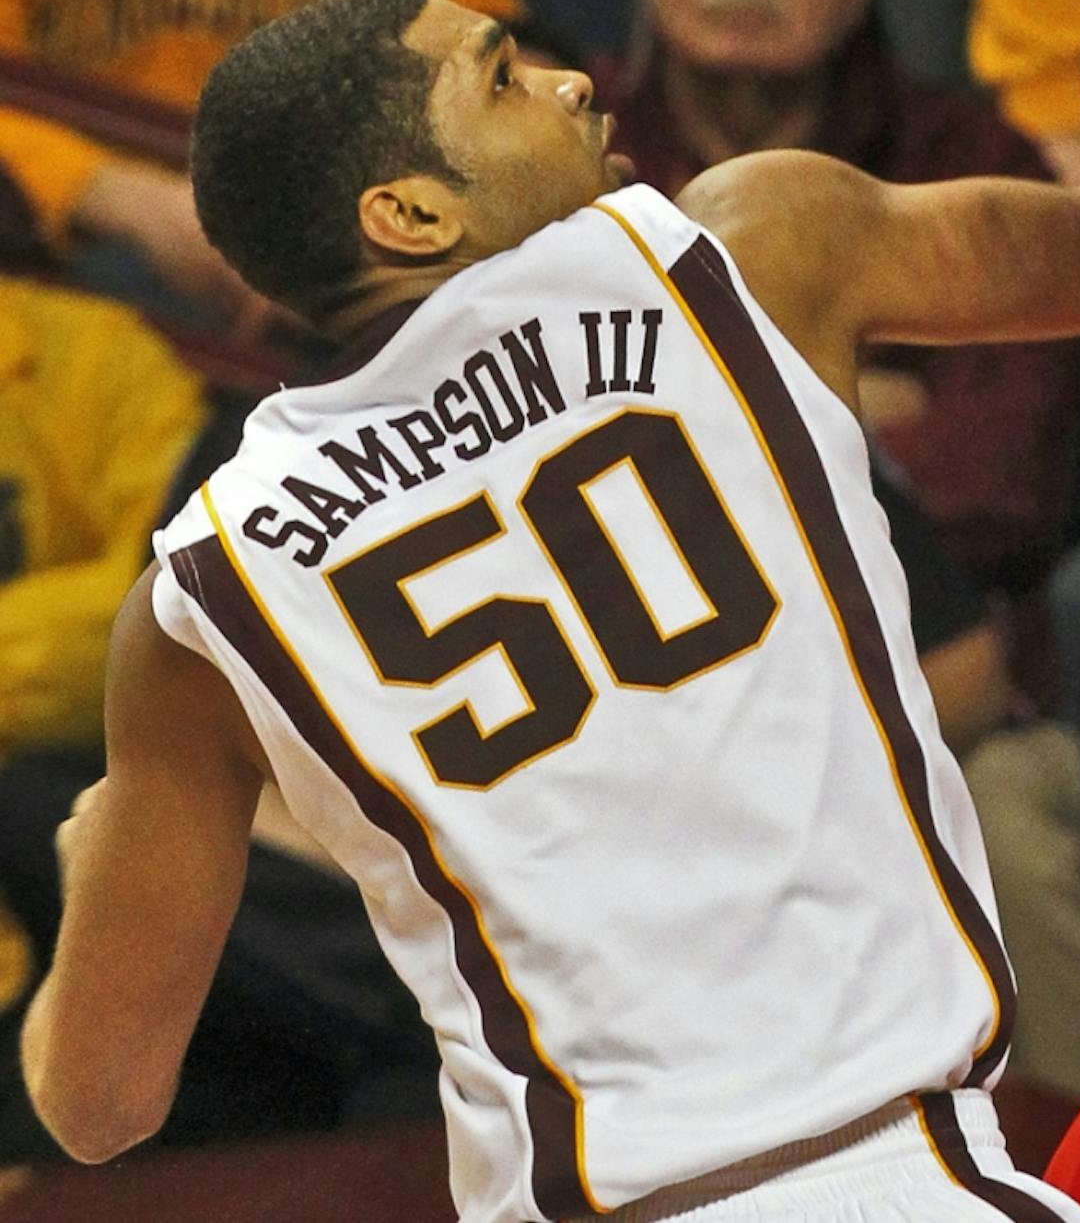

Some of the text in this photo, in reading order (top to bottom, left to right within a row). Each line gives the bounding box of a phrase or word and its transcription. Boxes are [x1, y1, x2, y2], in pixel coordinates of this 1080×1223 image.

[241, 308, 663, 569] SAMPSON III
[320, 405, 783, 792] 50
